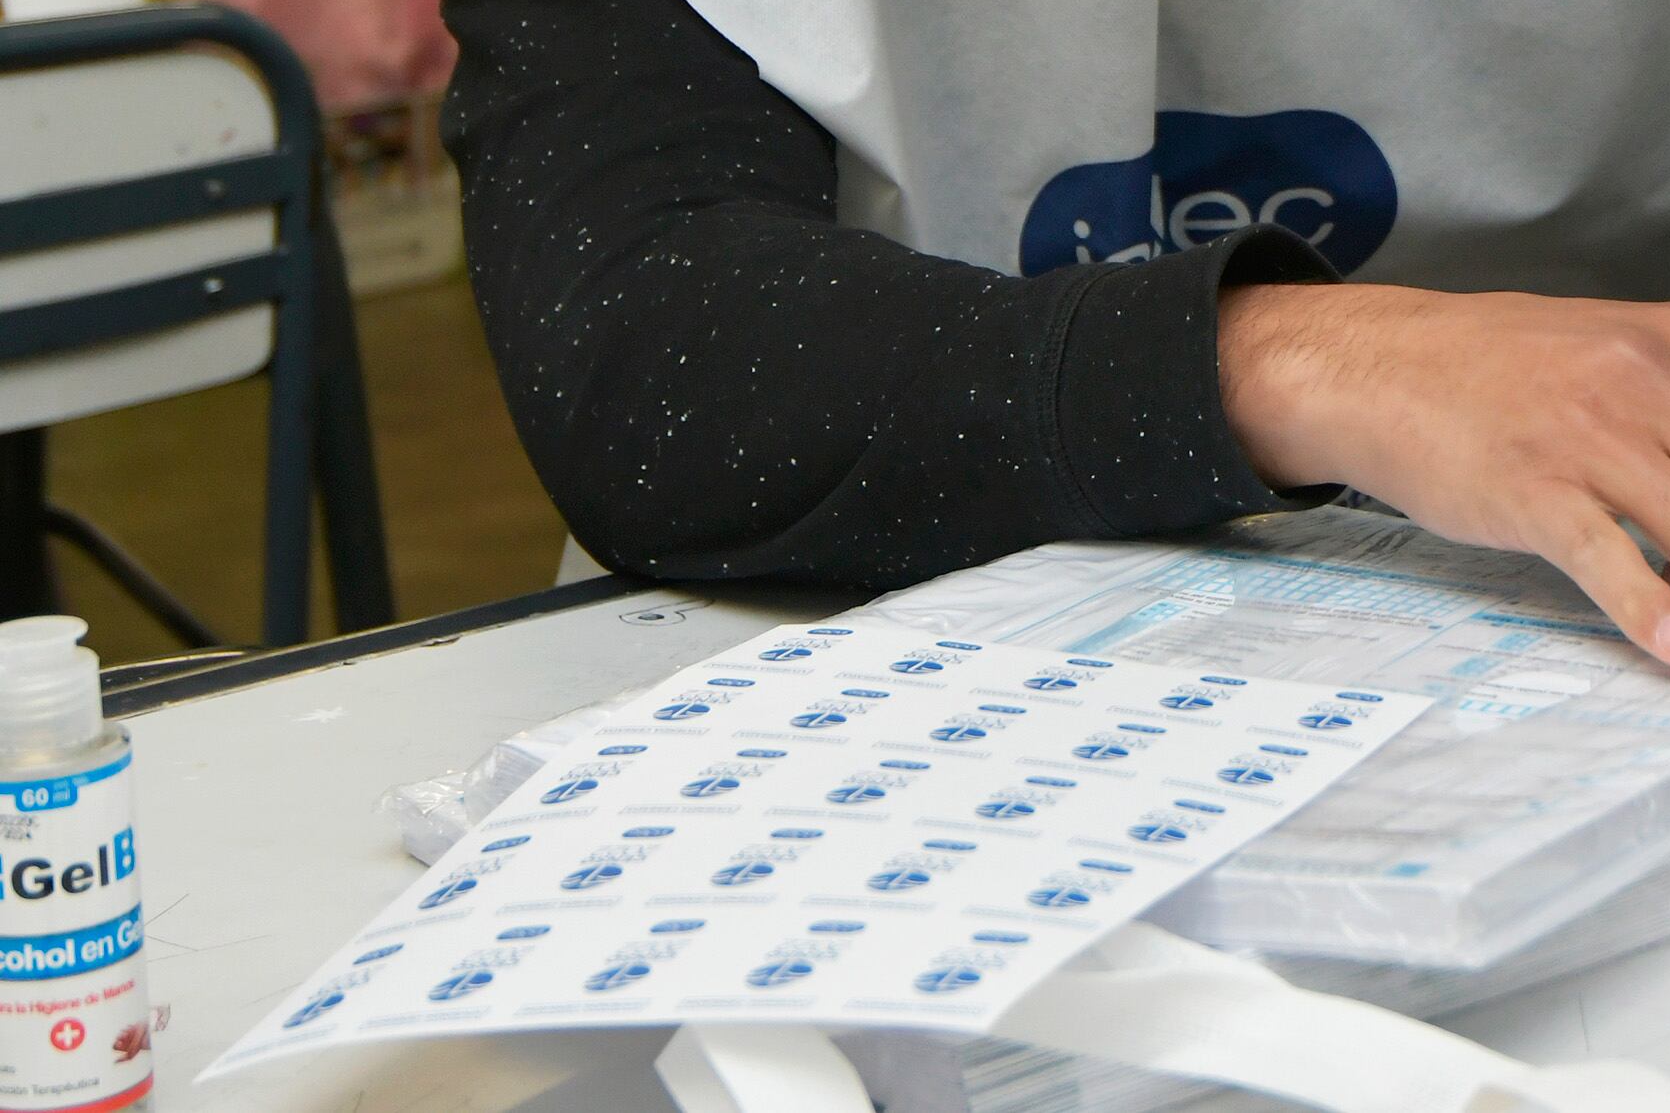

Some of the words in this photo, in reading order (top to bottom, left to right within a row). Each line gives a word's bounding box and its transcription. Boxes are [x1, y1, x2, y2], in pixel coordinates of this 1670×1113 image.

[21, 787, 49, 808] 60
[0, 825, 136, 899] GelB
[81, 934, 115, 963] en
